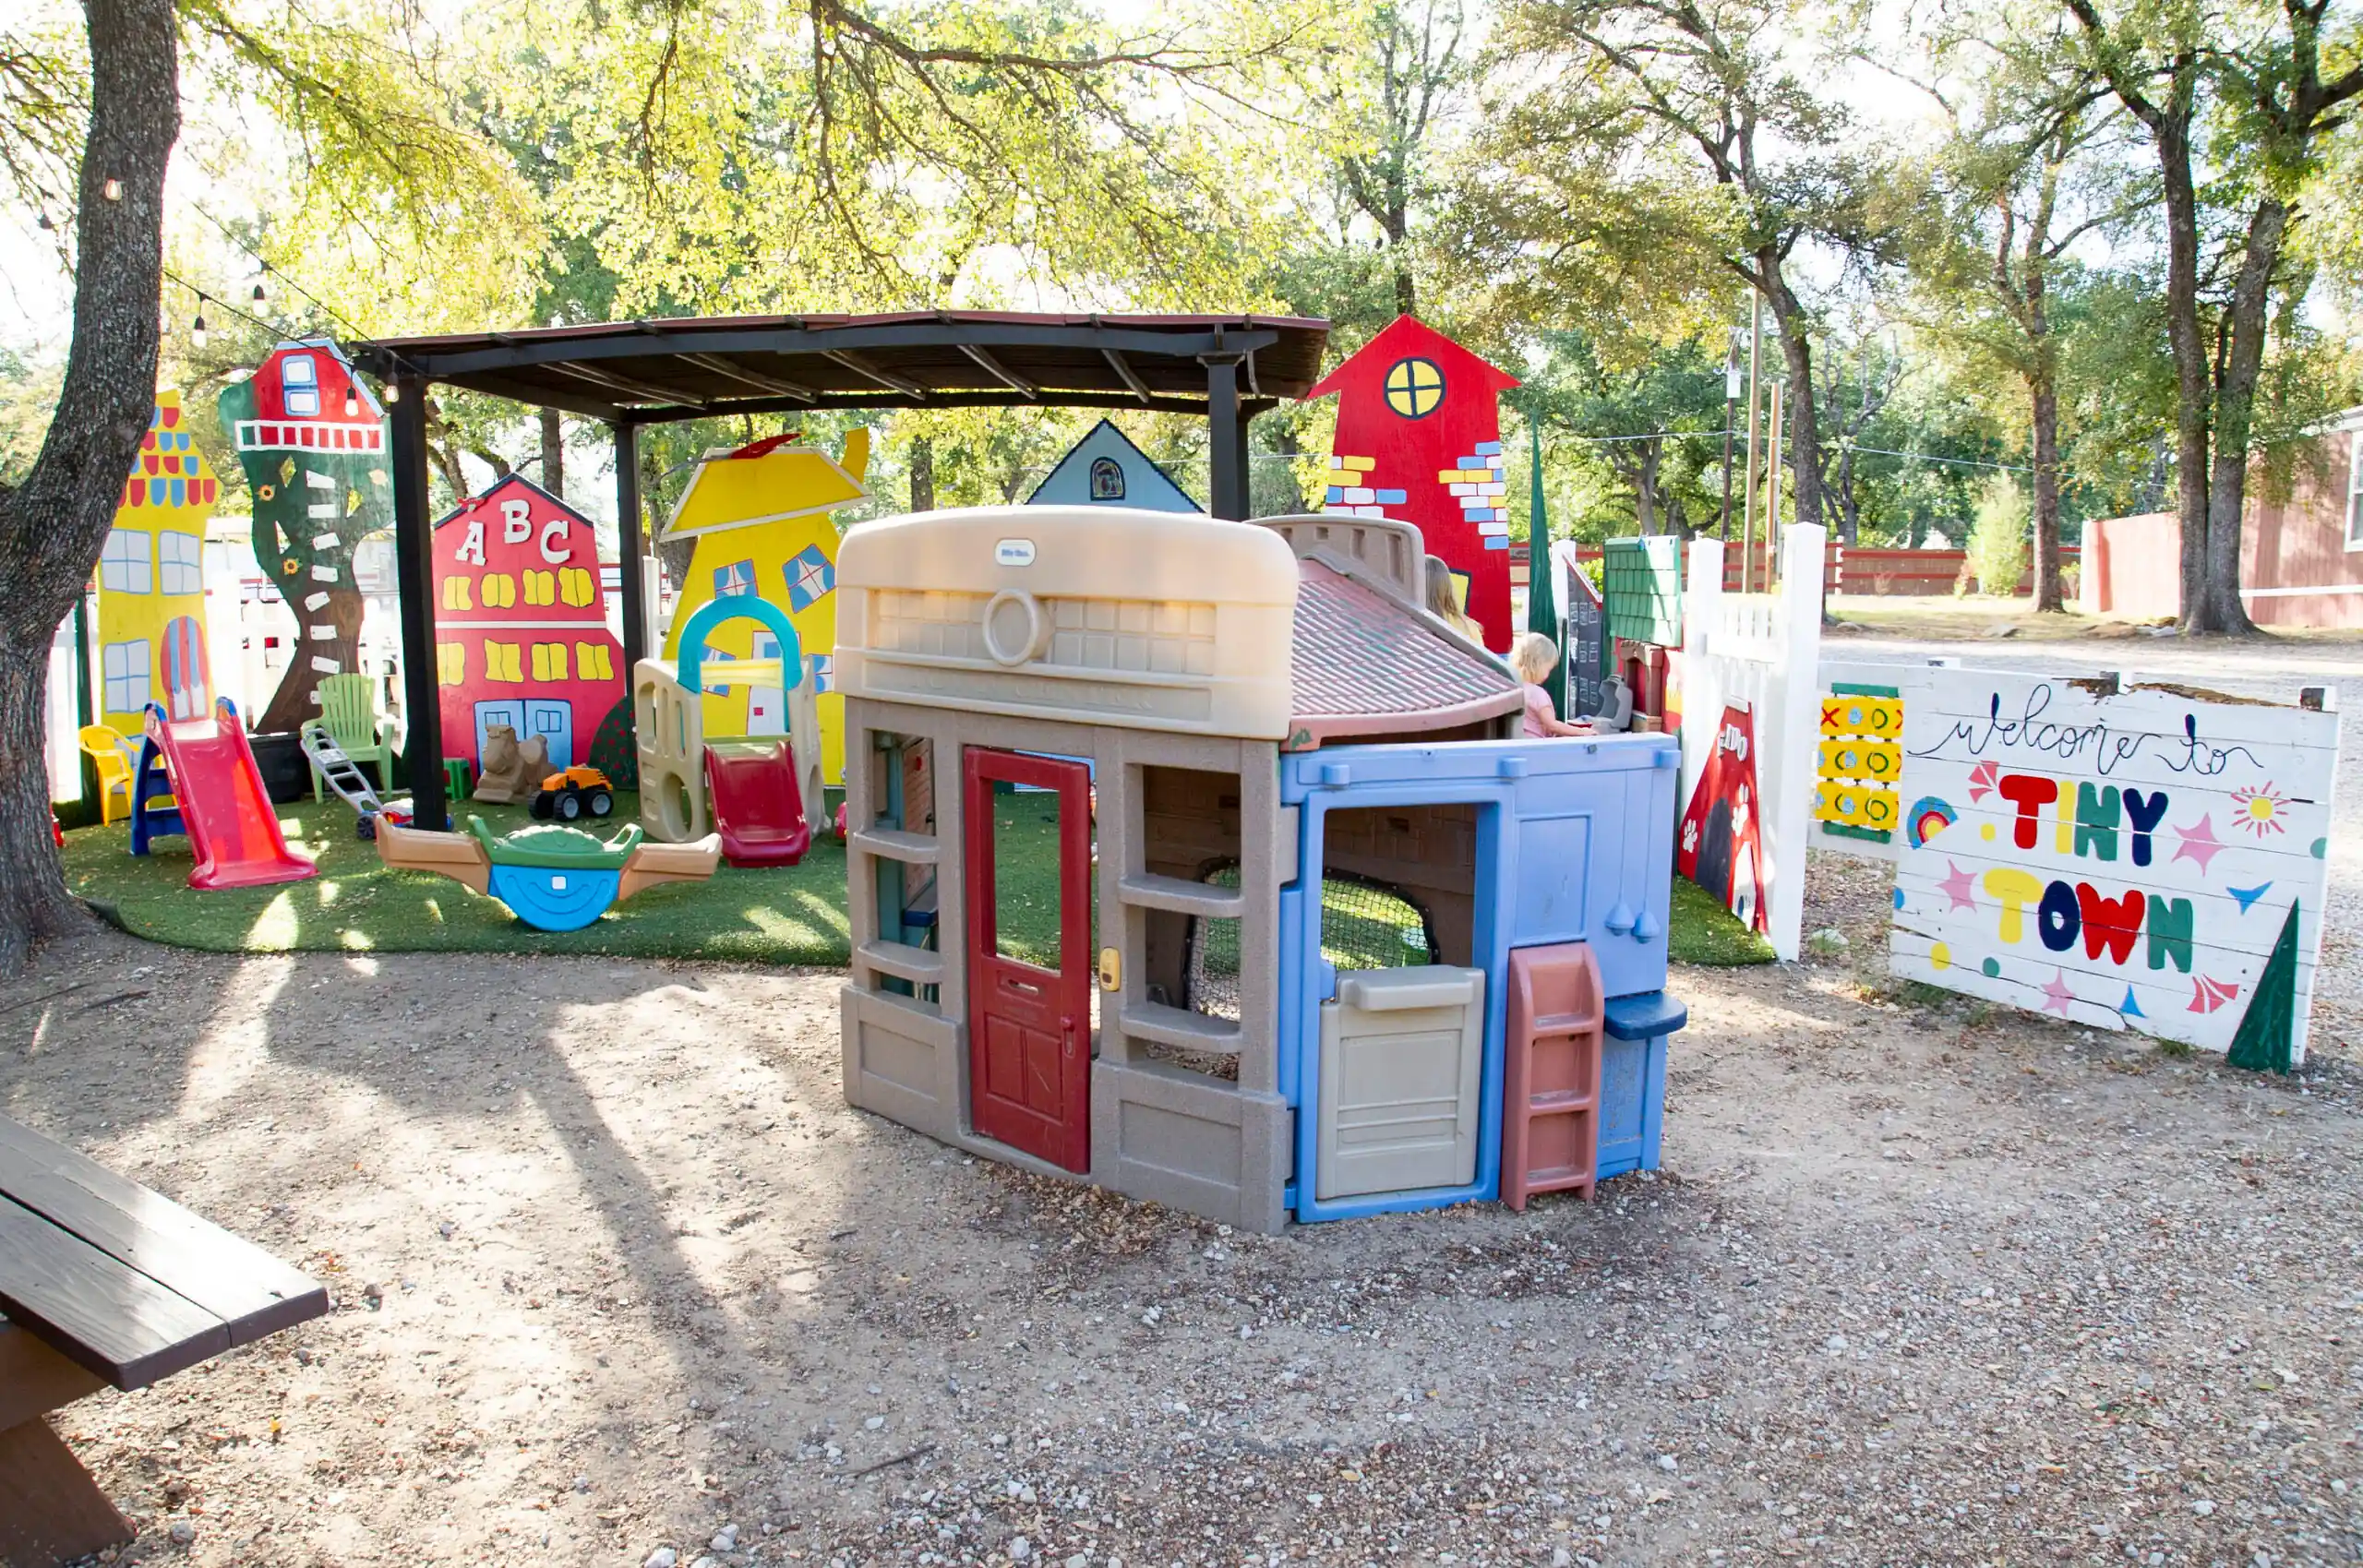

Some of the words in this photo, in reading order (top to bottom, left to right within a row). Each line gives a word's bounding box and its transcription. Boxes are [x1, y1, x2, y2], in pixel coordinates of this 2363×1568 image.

[2153, 713, 2263, 775] to
[1999, 774, 2168, 867] TINY
[1983, 868, 2193, 974] TOWN
